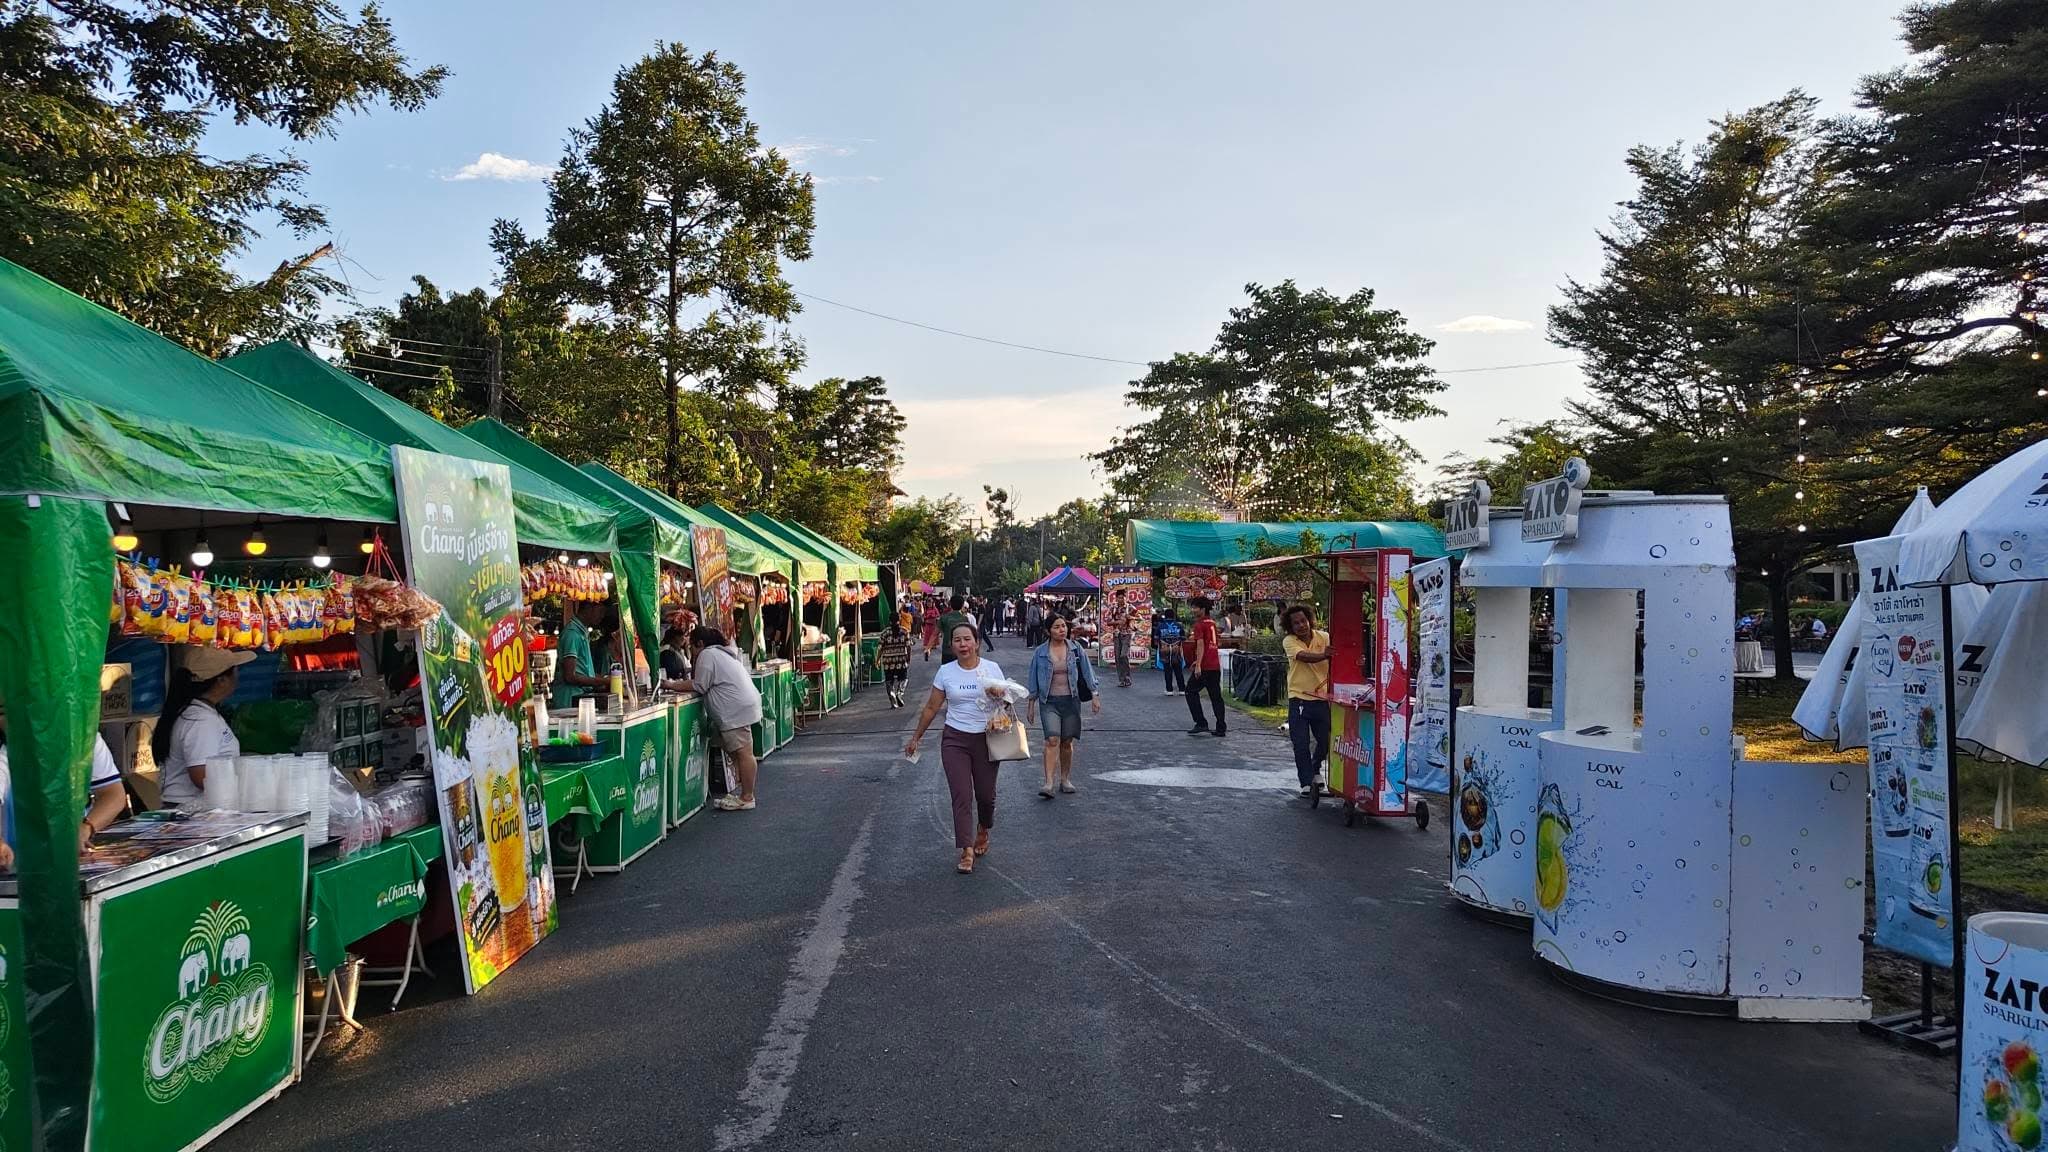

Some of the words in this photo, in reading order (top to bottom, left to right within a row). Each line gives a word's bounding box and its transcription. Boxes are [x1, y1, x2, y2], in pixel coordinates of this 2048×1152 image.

[1523, 481, 1569, 522] ZATO
[1446, 500, 1478, 533] ZATO
[1523, 520, 1565, 538] SPARKLING
[420, 525, 465, 561] Chang
[467, 522, 508, 565] เบียร์ช้าง
[1446, 532, 1479, 546] SPARKLING
[1106, 574, 1148, 590] จุดจำหน่าย
[1419, 574, 1444, 593] ZATO
[1871, 565, 1905, 593] ZA
[492, 621, 515, 649] แก้วละ
[1874, 647, 1890, 656] LOW
[1899, 644, 1911, 653] NEW
[492, 636, 525, 693] 100
[509, 676, 523, 697] บาท
[1903, 683, 1926, 694] ZATO
[104, 701, 127, 710] THONG
[105, 693, 127, 701] HONG
[1501, 725, 1533, 736] LOW
[1508, 740, 1532, 748] CAL
[1874, 751, 1892, 763] ZATO
[1588, 761, 1624, 775] LOW
[1596, 779, 1623, 789] CAL
[633, 782, 659, 815] Chang
[490, 814, 520, 844] Chang
[1913, 824, 1932, 840] ZATO
[1983, 1003, 2048, 1031] SPARKLIN
[150, 983, 269, 1080] Chang
